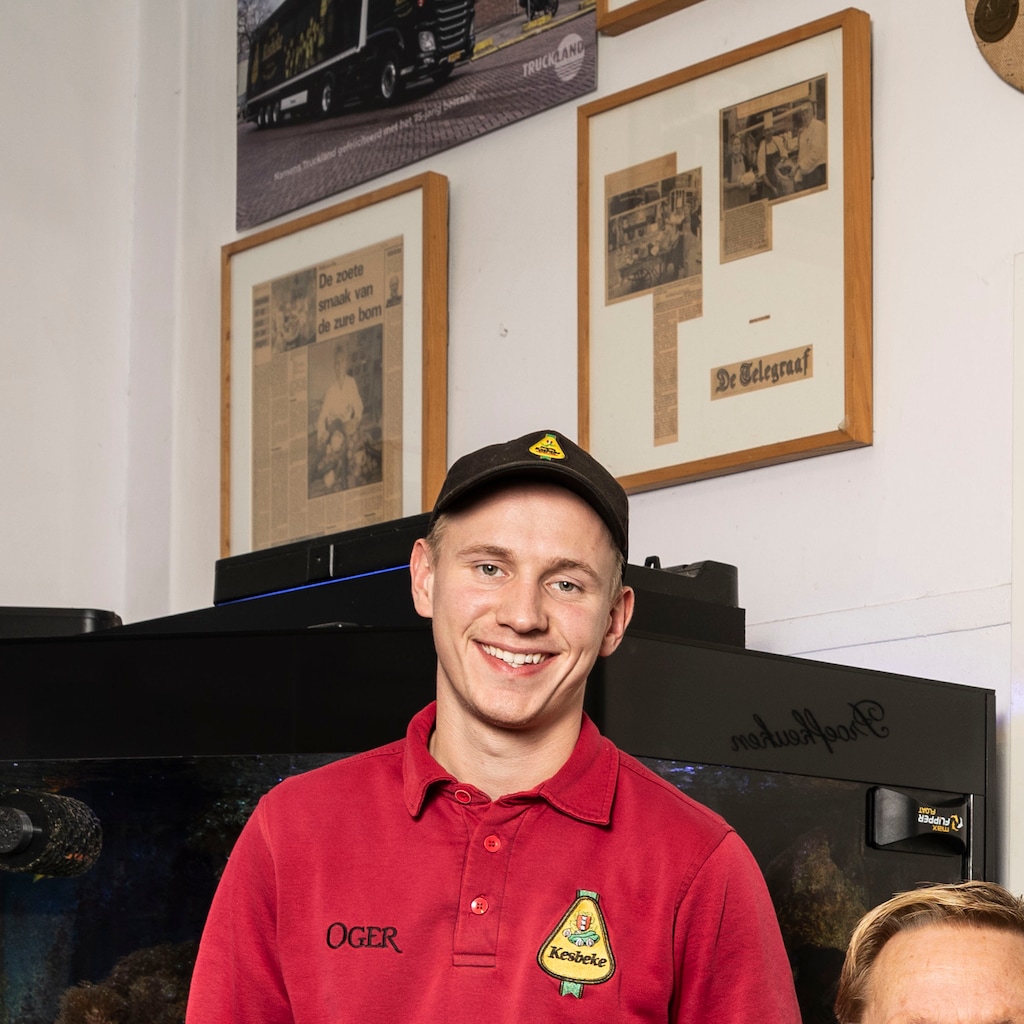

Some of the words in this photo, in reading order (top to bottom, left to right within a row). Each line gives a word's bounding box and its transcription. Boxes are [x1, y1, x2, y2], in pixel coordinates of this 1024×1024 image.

[522, 40, 586, 77] TRUCKLAND
[319, 273, 333, 289] De
[336, 264, 364, 282] zoete
[318, 290, 351, 312] smaak
[354, 283, 373, 300] van
[318, 319, 330, 335] de
[334, 313, 355, 330] zure
[359, 304, 381, 322] bom
[715, 368, 736, 393] De
[740, 347, 811, 387] Telegraaf
[918, 807, 936, 815] FLOAT
[918, 814, 950, 826] FLIPPER
[932, 825, 950, 833] max
[326, 922, 403, 954] OGER
[547, 945, 609, 968] Kesbeke
